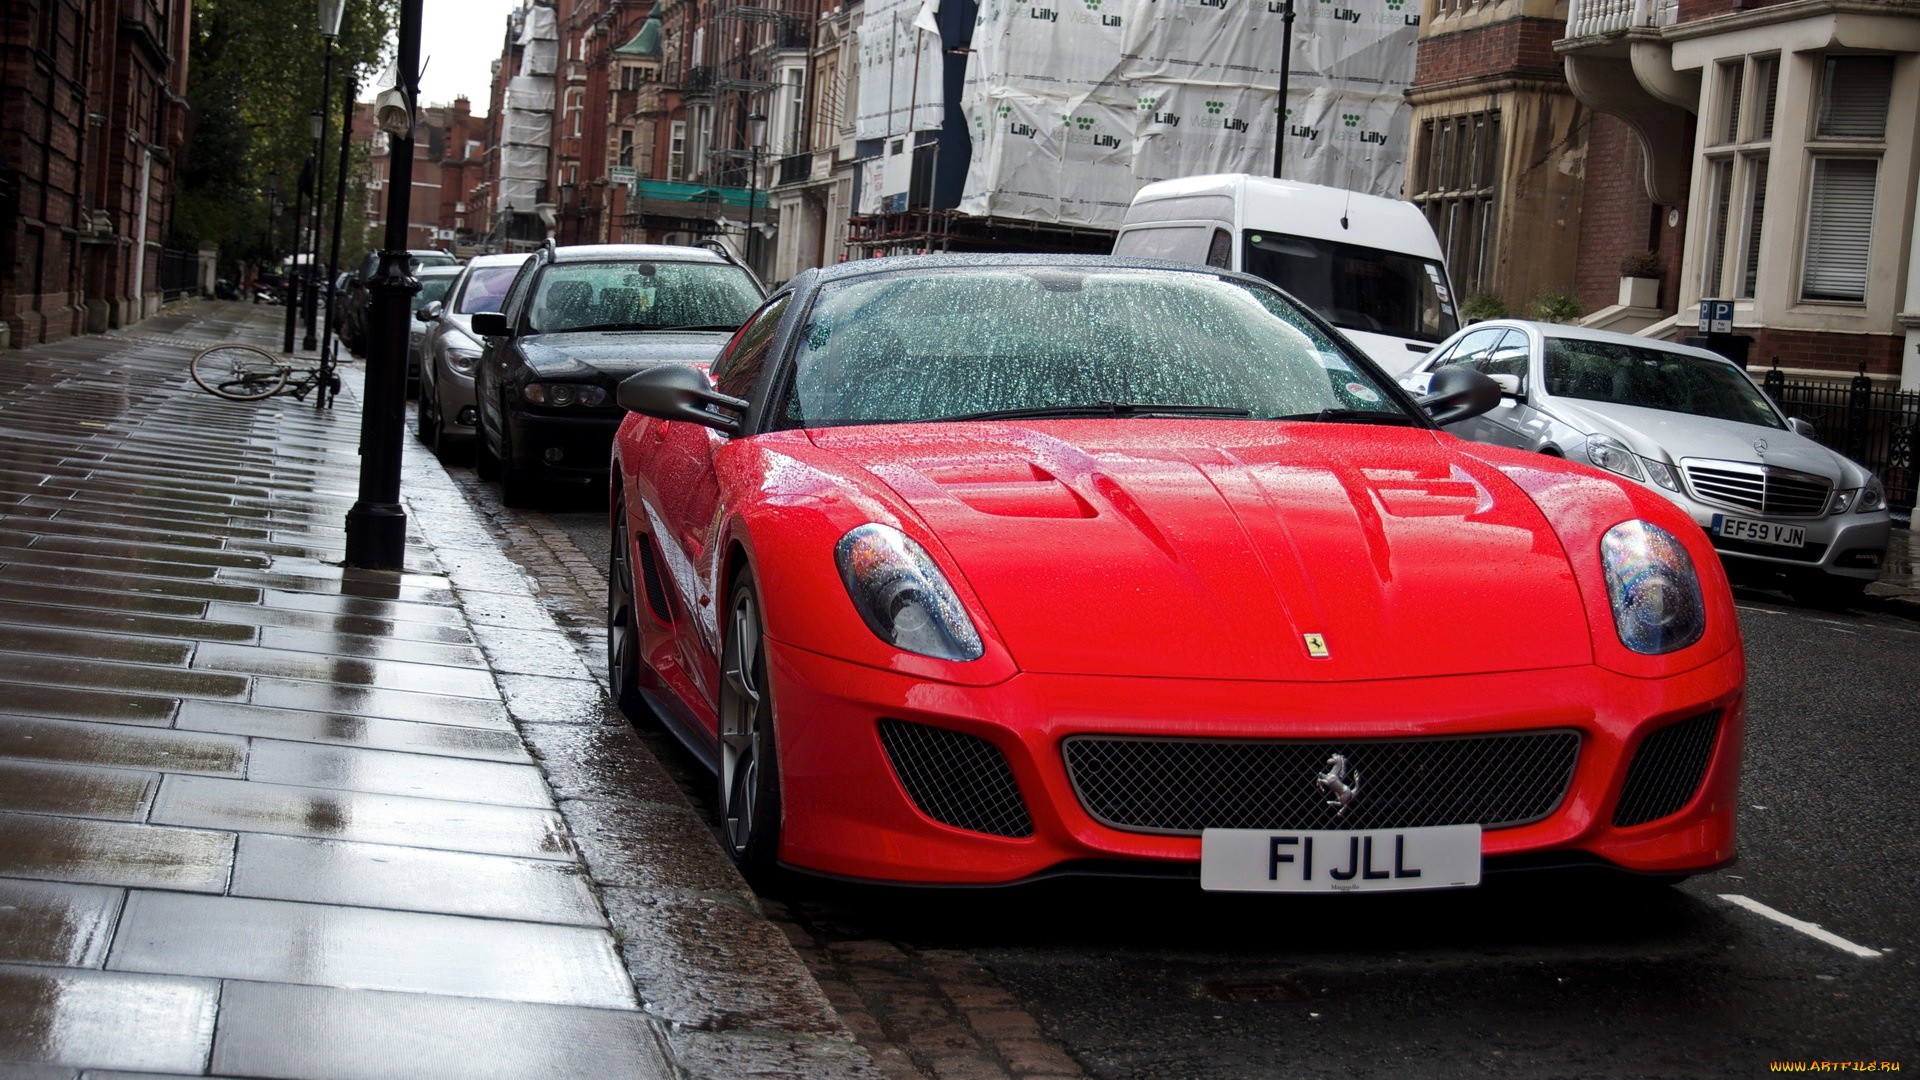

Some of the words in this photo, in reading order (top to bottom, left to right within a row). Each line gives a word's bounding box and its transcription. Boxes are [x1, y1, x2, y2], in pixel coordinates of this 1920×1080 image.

[1030, 7, 1059, 23] Lilly
[1267, 1, 1287, 14] Lill
[1333, 7, 1362, 24] Lilly
[1101, 14, 1123, 28] Lill
[1404, 14, 1421, 27] Lil
[1154, 112, 1181, 128] Lilly
[1223, 117, 1250, 134] Lilly
[1010, 122, 1038, 140] Lilly
[1290, 124, 1319, 141] Lilly
[1359, 130, 1388, 146] Lilly
[1093, 134, 1122, 150] Lilly
[1701, 303, 1708, 319] P
[1716, 303, 1729, 320] P
[1723, 518, 1769, 540] EF59
[1774, 526, 1804, 545] VJN
[1329, 834, 1421, 881] JLL
